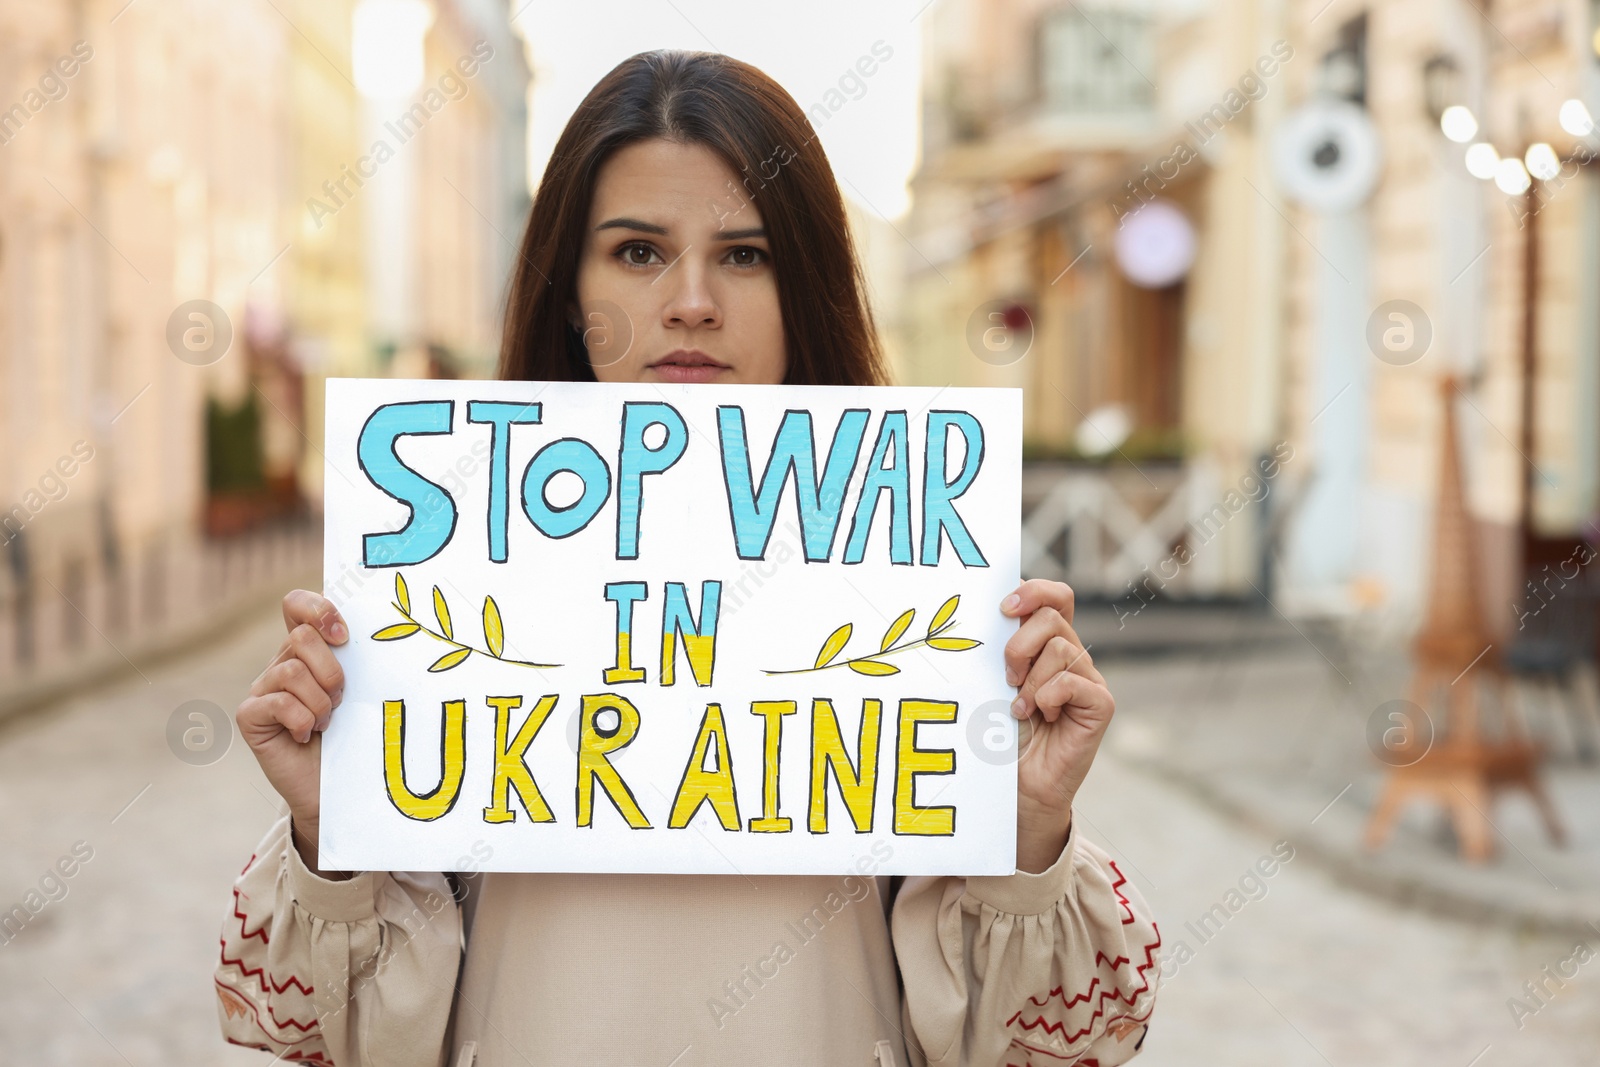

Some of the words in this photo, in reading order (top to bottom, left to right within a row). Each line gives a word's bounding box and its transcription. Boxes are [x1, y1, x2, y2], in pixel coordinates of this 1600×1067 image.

[358, 400, 689, 568] STOP
[717, 404, 989, 567] WAR
[603, 580, 722, 687] IN
[383, 693, 959, 837] UKRAINE
